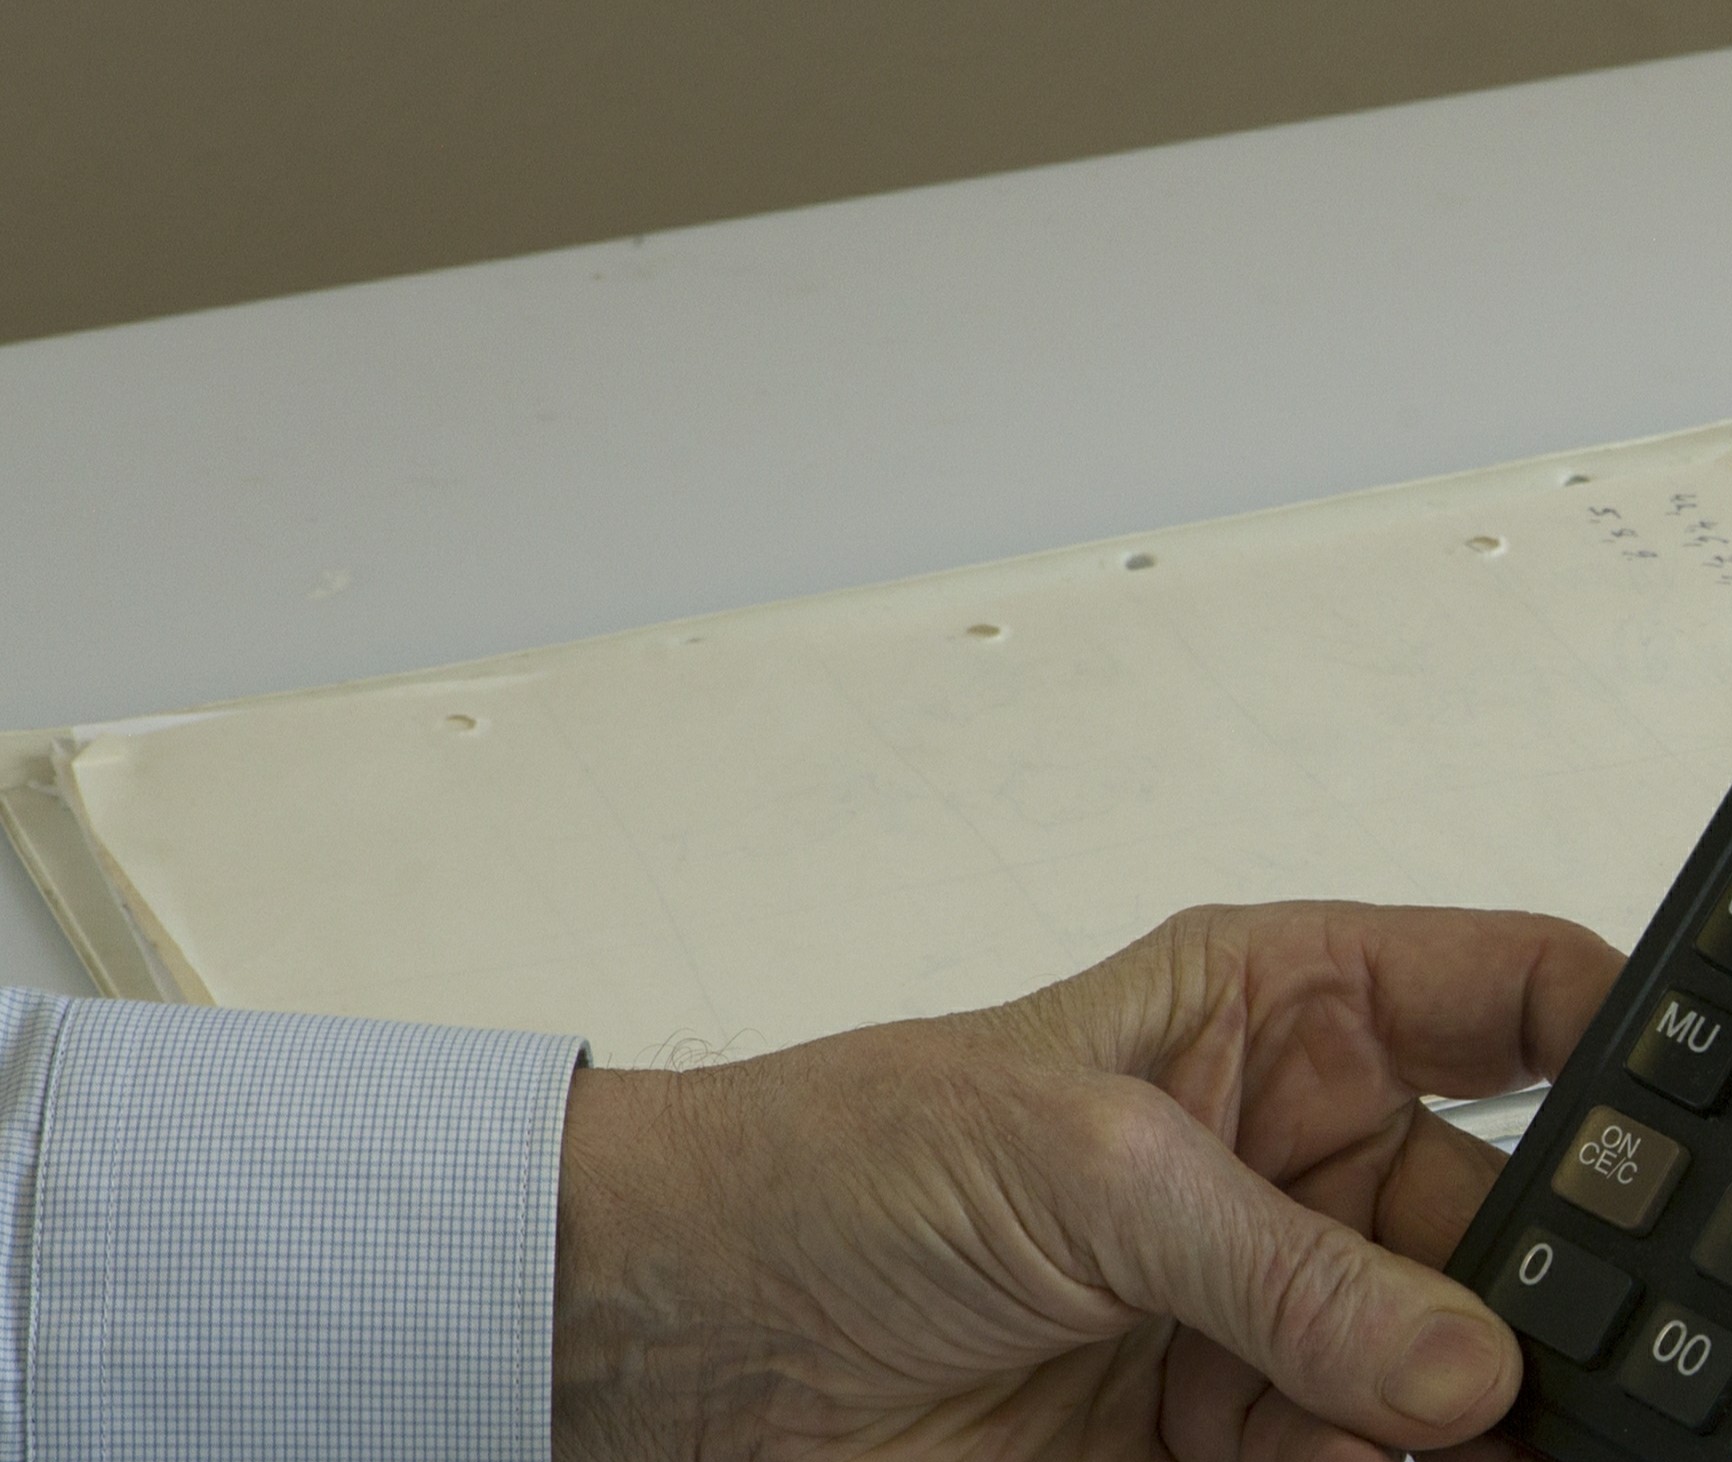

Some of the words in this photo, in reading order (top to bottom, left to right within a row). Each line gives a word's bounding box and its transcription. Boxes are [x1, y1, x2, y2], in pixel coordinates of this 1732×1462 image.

[1656, 1002, 1721, 1053] MU
[1578, 1141, 1638, 1185] CE/C
[1600, 1124, 1641, 1158] ON
[1518, 1242, 1553, 1285] 0
[1652, 1319, 1711, 1375] 00
